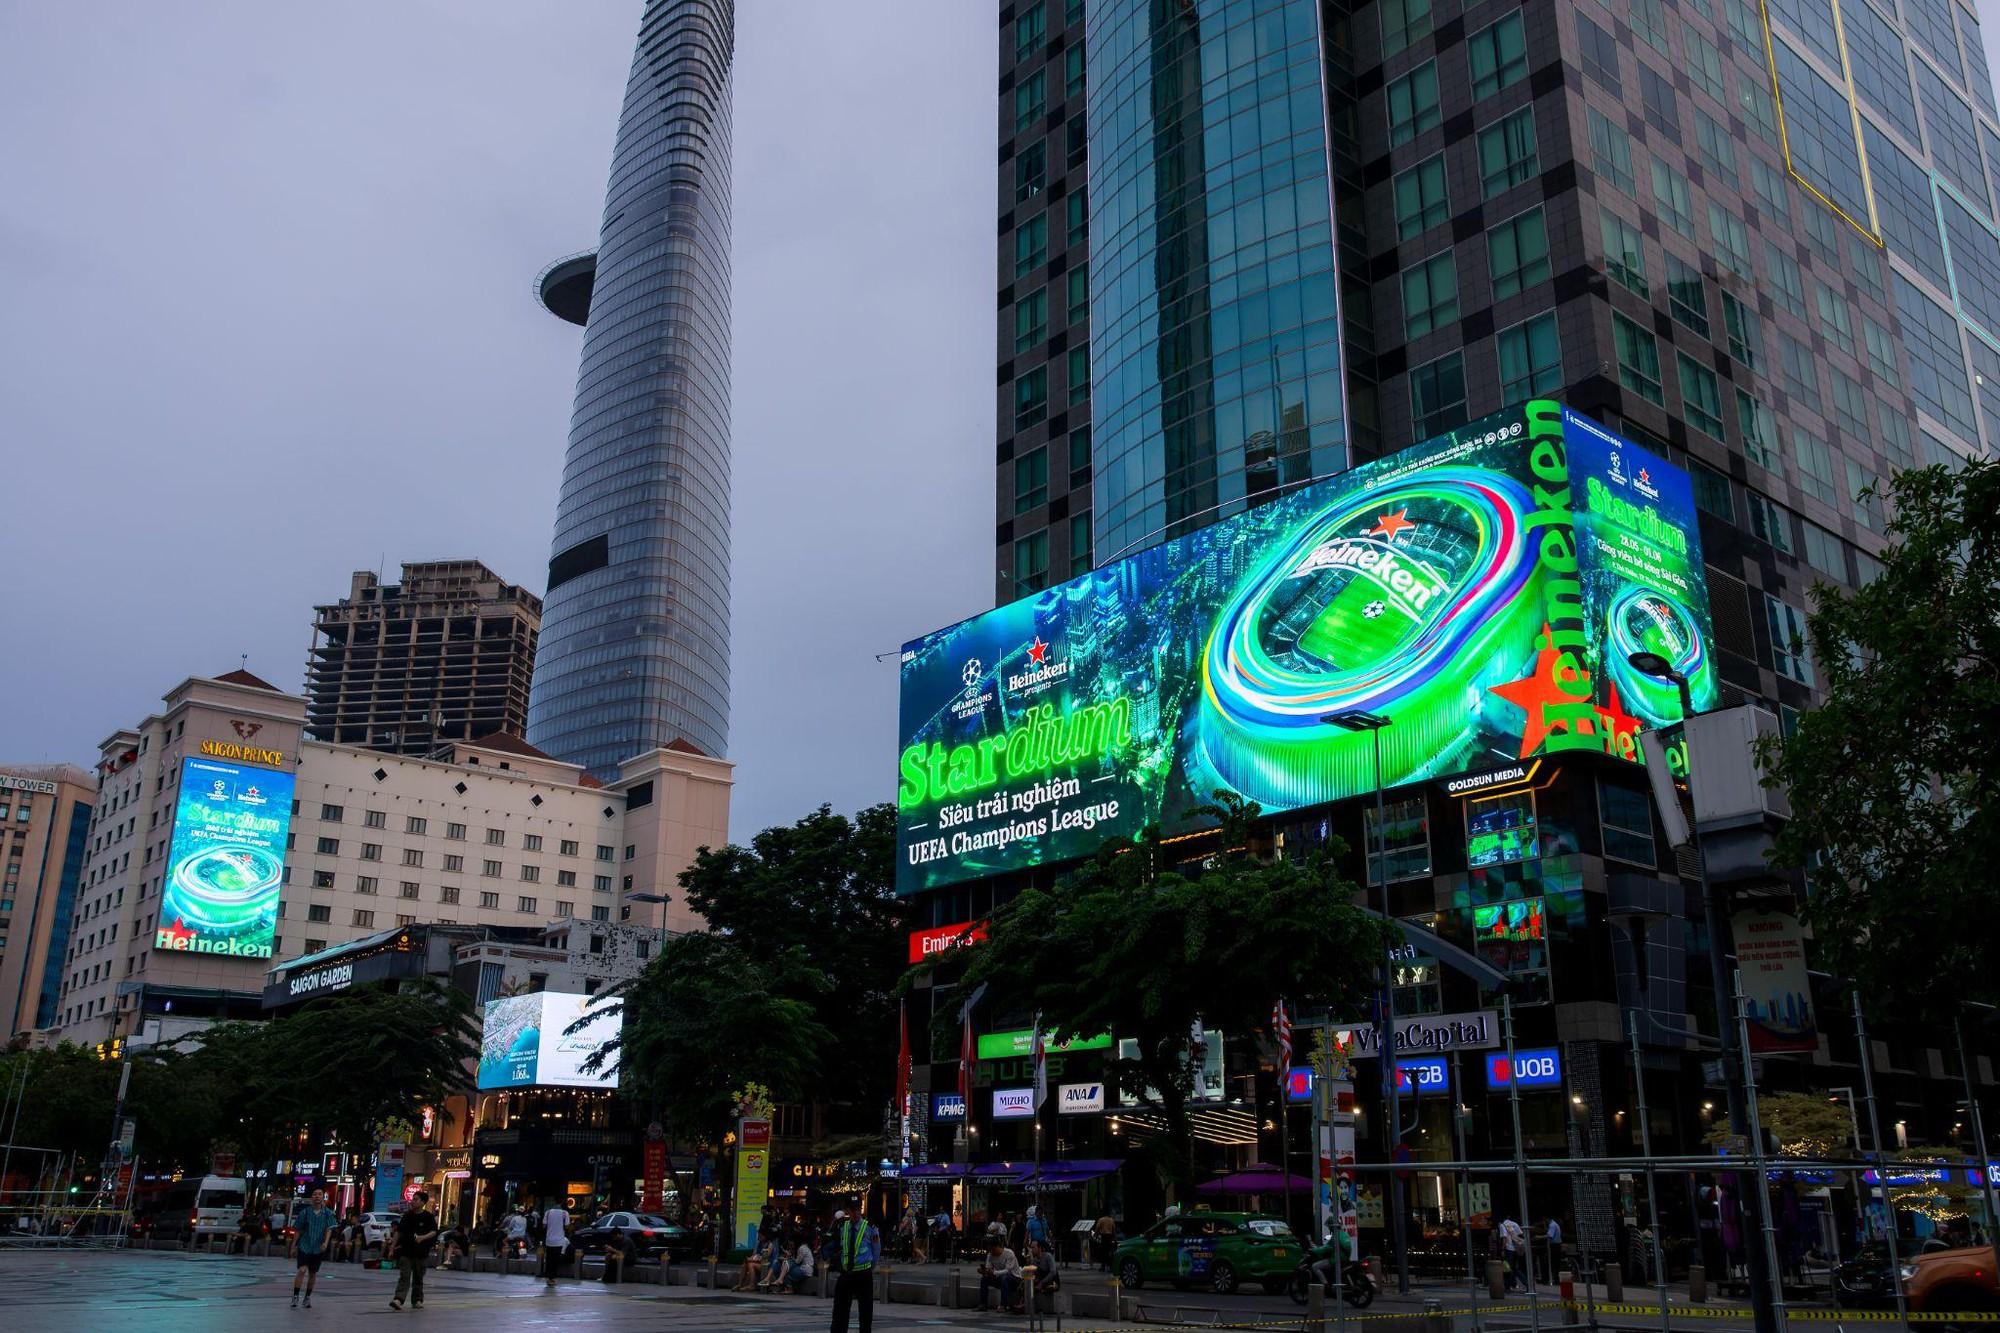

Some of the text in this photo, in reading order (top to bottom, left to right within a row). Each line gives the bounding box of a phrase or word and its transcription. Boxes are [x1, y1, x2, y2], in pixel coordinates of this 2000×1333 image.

[1587, 477, 1686, 554] Stardium
[1524, 400, 1604, 753] Heineken
[1008, 662, 1068, 692] Heineken
[951, 692, 993, 713] CHAMPIONS
[958, 704, 985, 719] LEAGUE
[201, 739, 282, 766] SAIGON PRINCE
[899, 697, 1131, 808] Stardium
[11, 777, 54, 793] TOWER
[1448, 767, 1525, 791] GOLDSUN MEDIA
[938, 776, 1081, 830] Siêu trải nghiệm
[908, 800, 1119, 866] UEFA Champions League
[156, 930, 272, 958] Heineken
[922, 932, 974, 954] Emirs
[290, 973, 320, 996] SAIGON
[320, 964, 353, 987] GARDEN
[1355, 1015, 1489, 1052] ViaCapital
[1514, 1056, 1555, 1079] UOB
[1000, 1095, 1030, 1106] MIZUHO
[1065, 1088, 1087, 1101] ANA
[937, 1103, 965, 1117] KPMG
